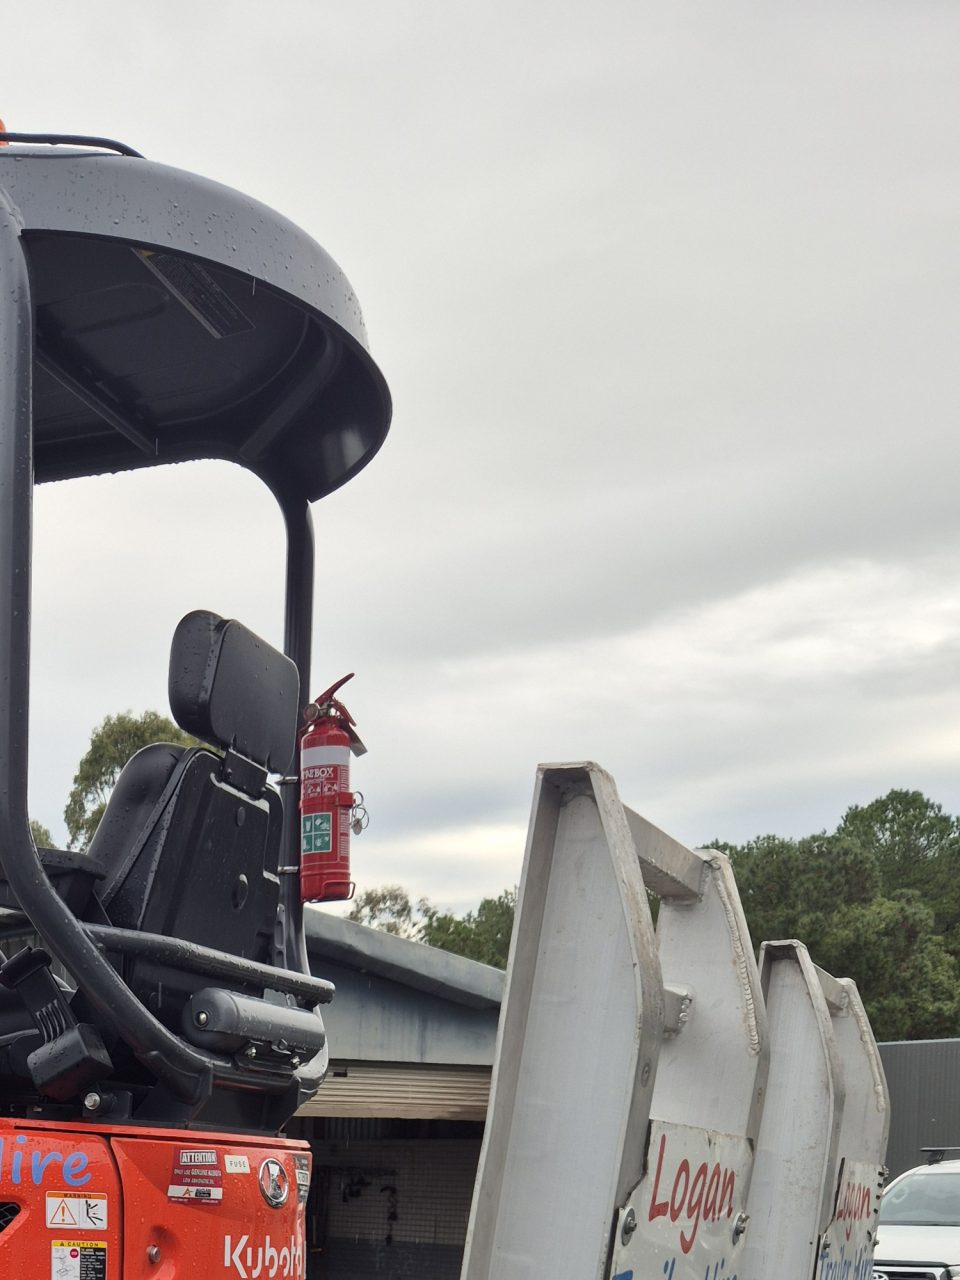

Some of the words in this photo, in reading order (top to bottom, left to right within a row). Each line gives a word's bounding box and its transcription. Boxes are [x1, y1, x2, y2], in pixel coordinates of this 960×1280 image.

[181, 1152, 216, 1163] ATTENTION
[230, 1160, 247, 1168] FUSE
[648, 1133, 736, 1255] Logan
[224, 1234, 303, 1279] Kubota
